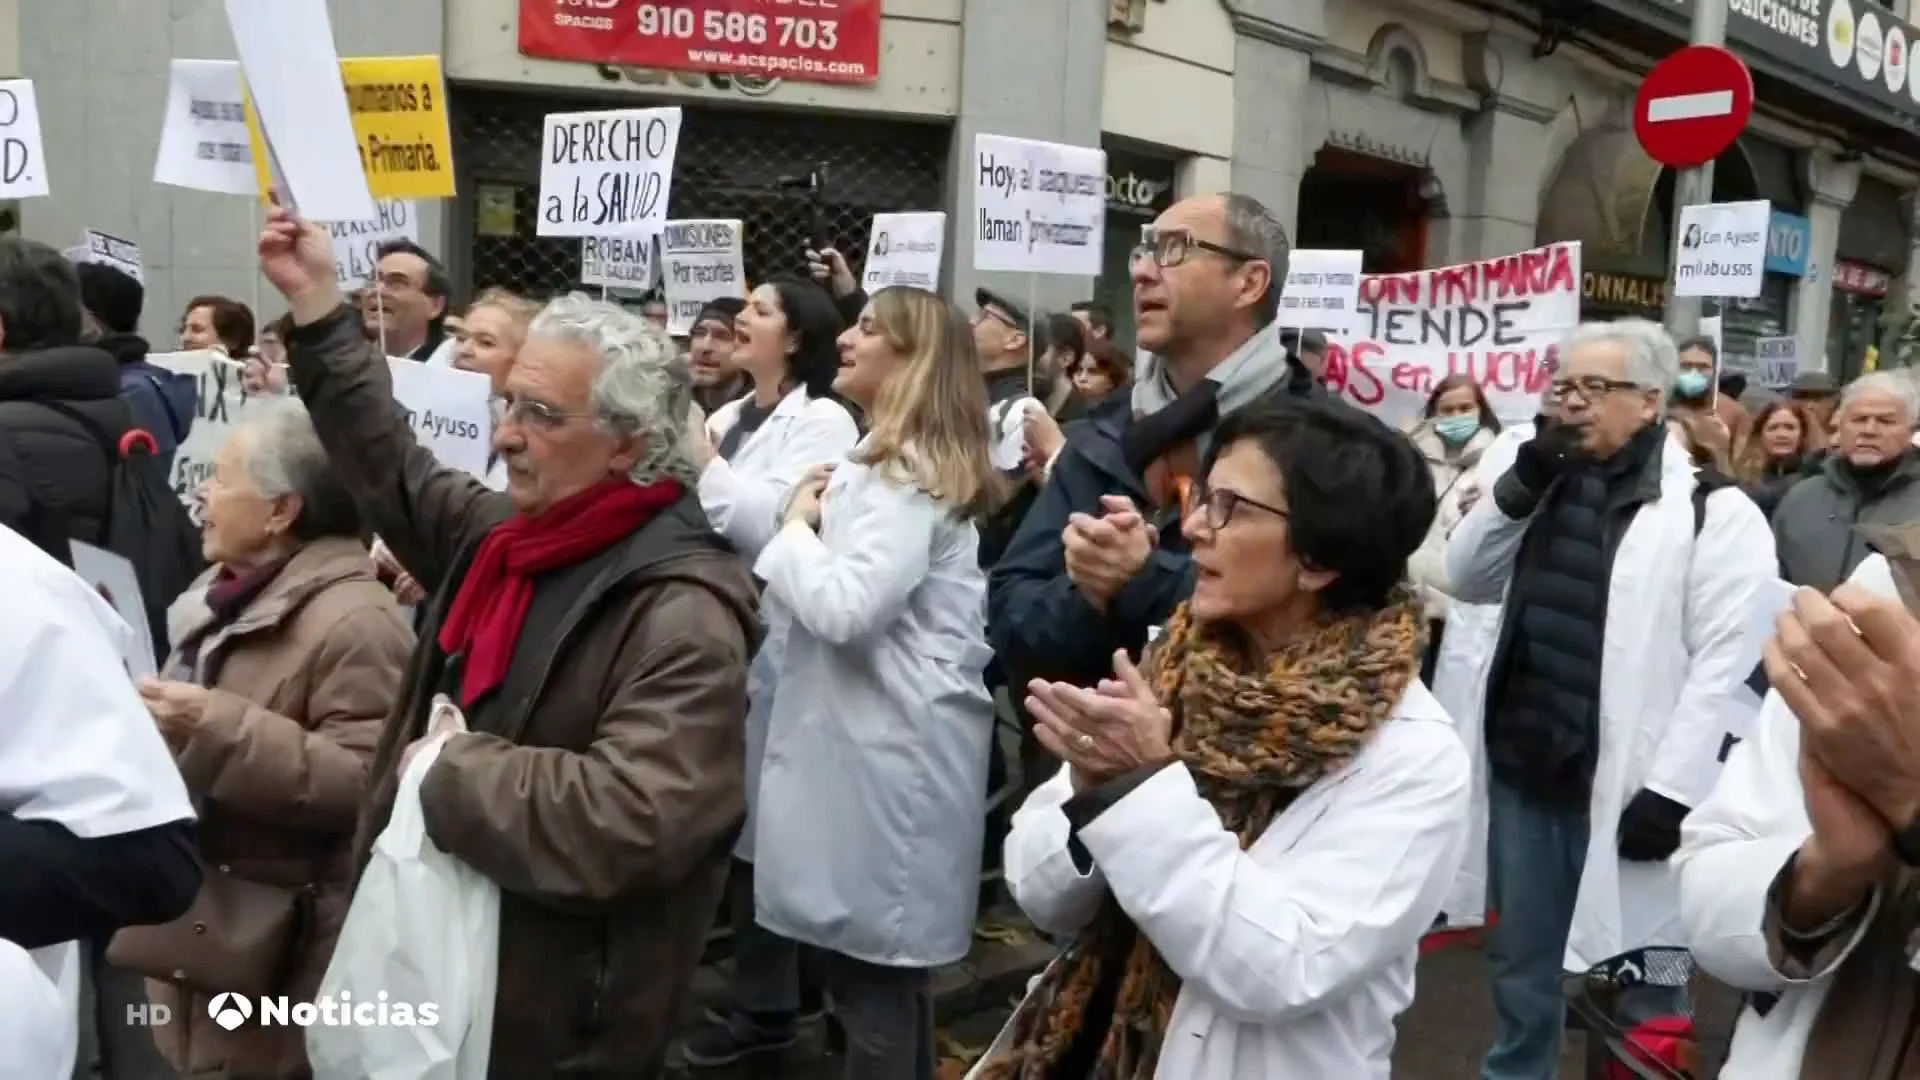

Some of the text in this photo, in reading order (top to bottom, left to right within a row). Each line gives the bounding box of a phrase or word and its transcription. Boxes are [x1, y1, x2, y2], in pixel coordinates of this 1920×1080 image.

[638, 6, 838, 50] 910 586 703
[345, 83, 433, 112] umanos a
[552, 117, 666, 163] DERECHO
[979, 152, 1017, 198] Hoy,
[545, 171, 661, 225] a la SALUD.
[979, 208, 1022, 241] llaman
[584, 236, 648, 265] ROBAN
[1430, 246, 1575, 308] PRIMARIA
[421, 409, 479, 440] Ayuso
